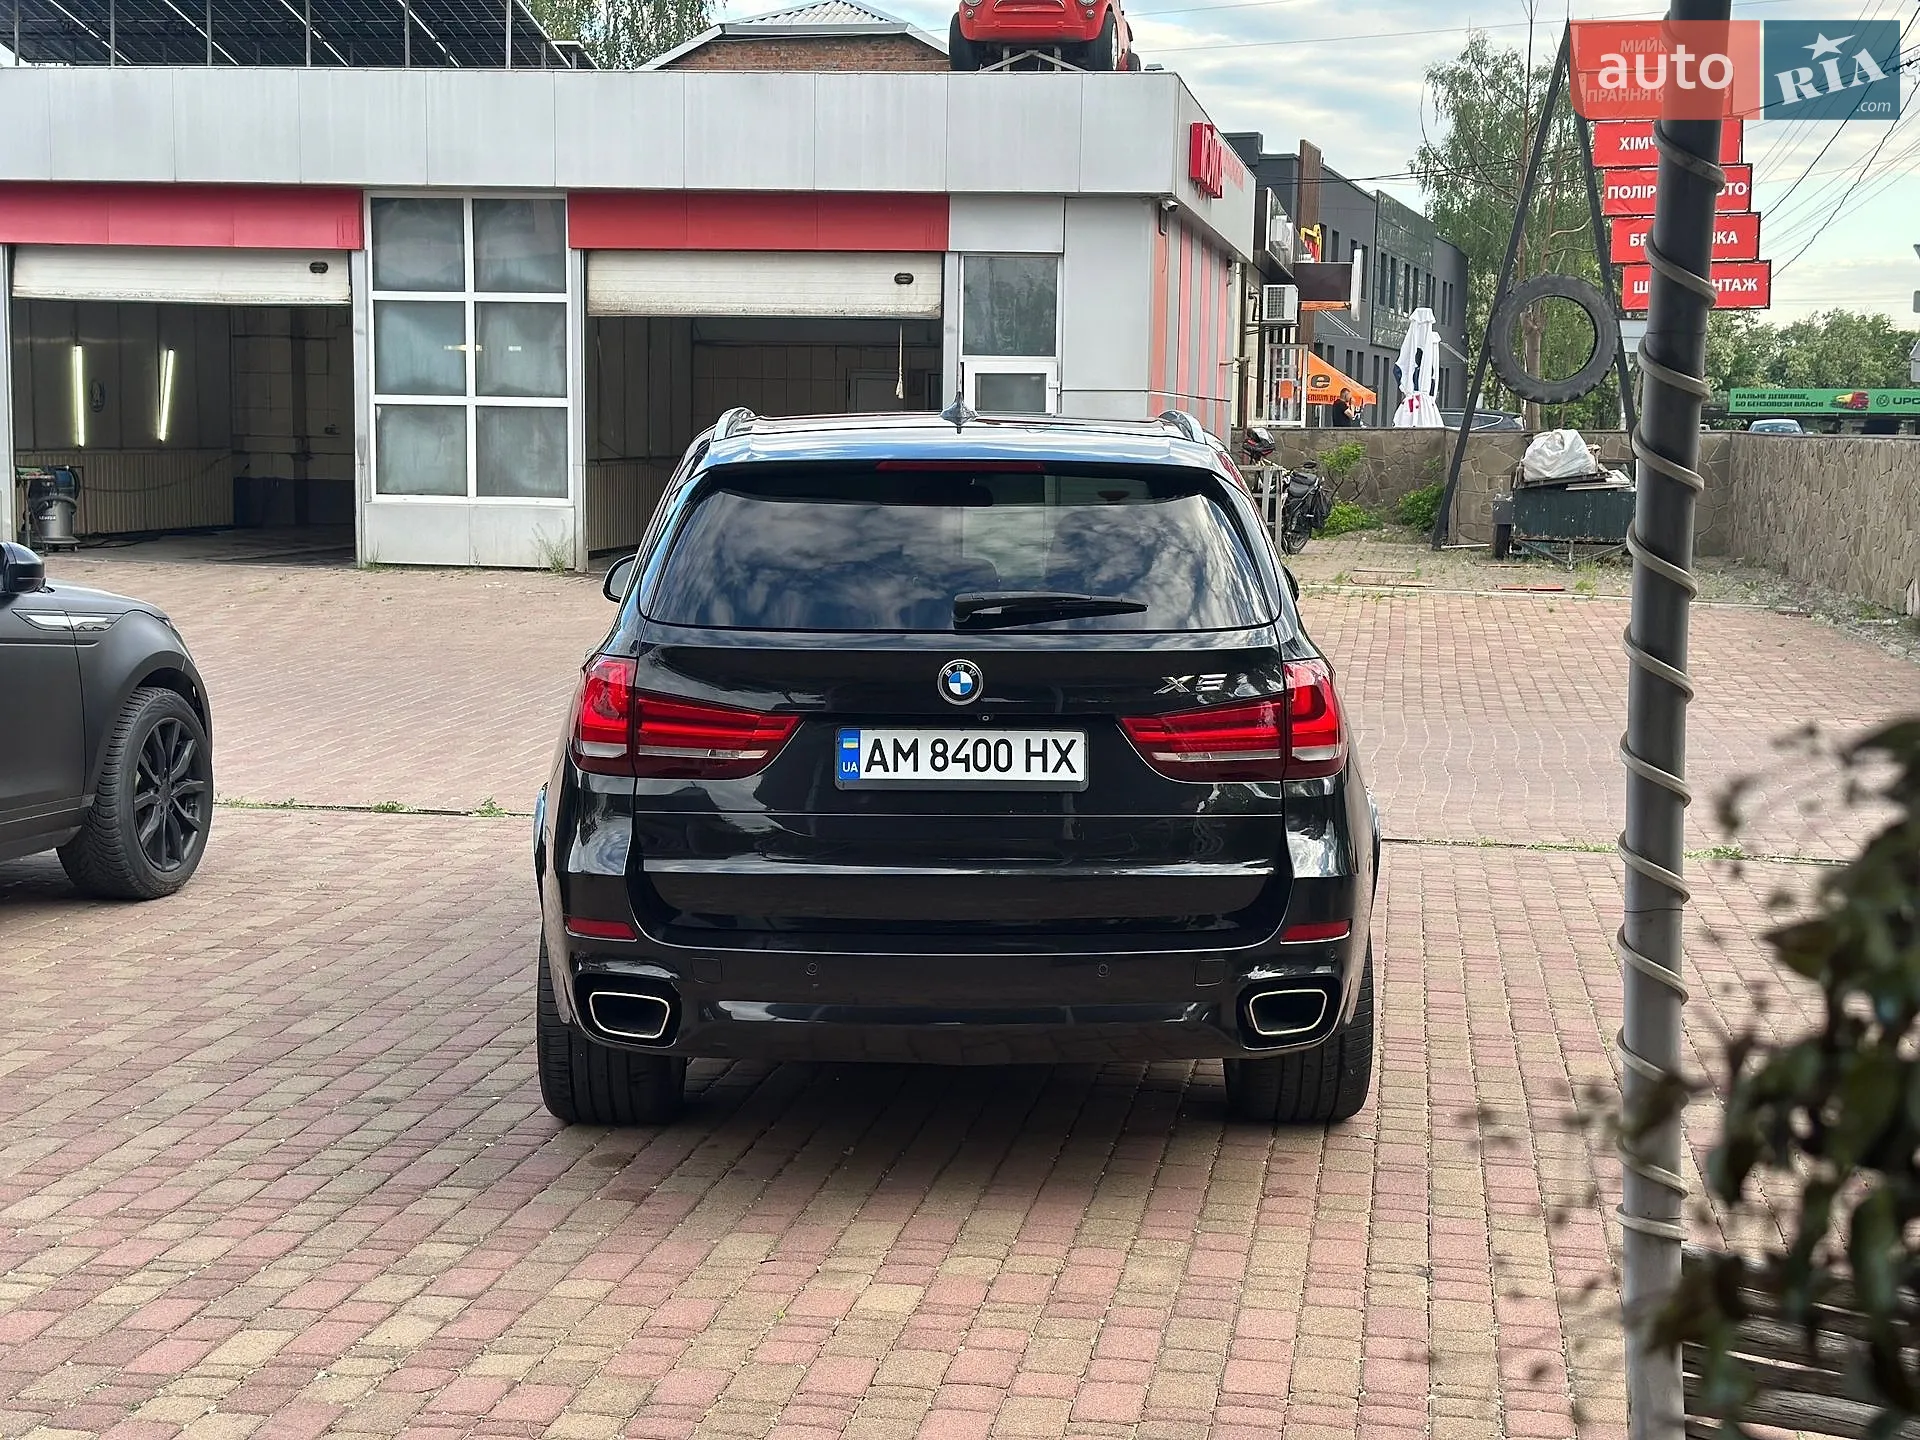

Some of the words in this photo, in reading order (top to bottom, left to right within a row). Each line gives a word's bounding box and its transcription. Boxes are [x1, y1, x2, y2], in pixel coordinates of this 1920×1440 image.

[1586, 87, 1651, 103] ПРАННЯ
[1607, 184, 1658, 199] ПОЛІР
[864, 737, 919, 773] AM
[929, 737, 1013, 773] 8400
[1025, 737, 1077, 774] HX
[842, 761, 859, 773] UA
